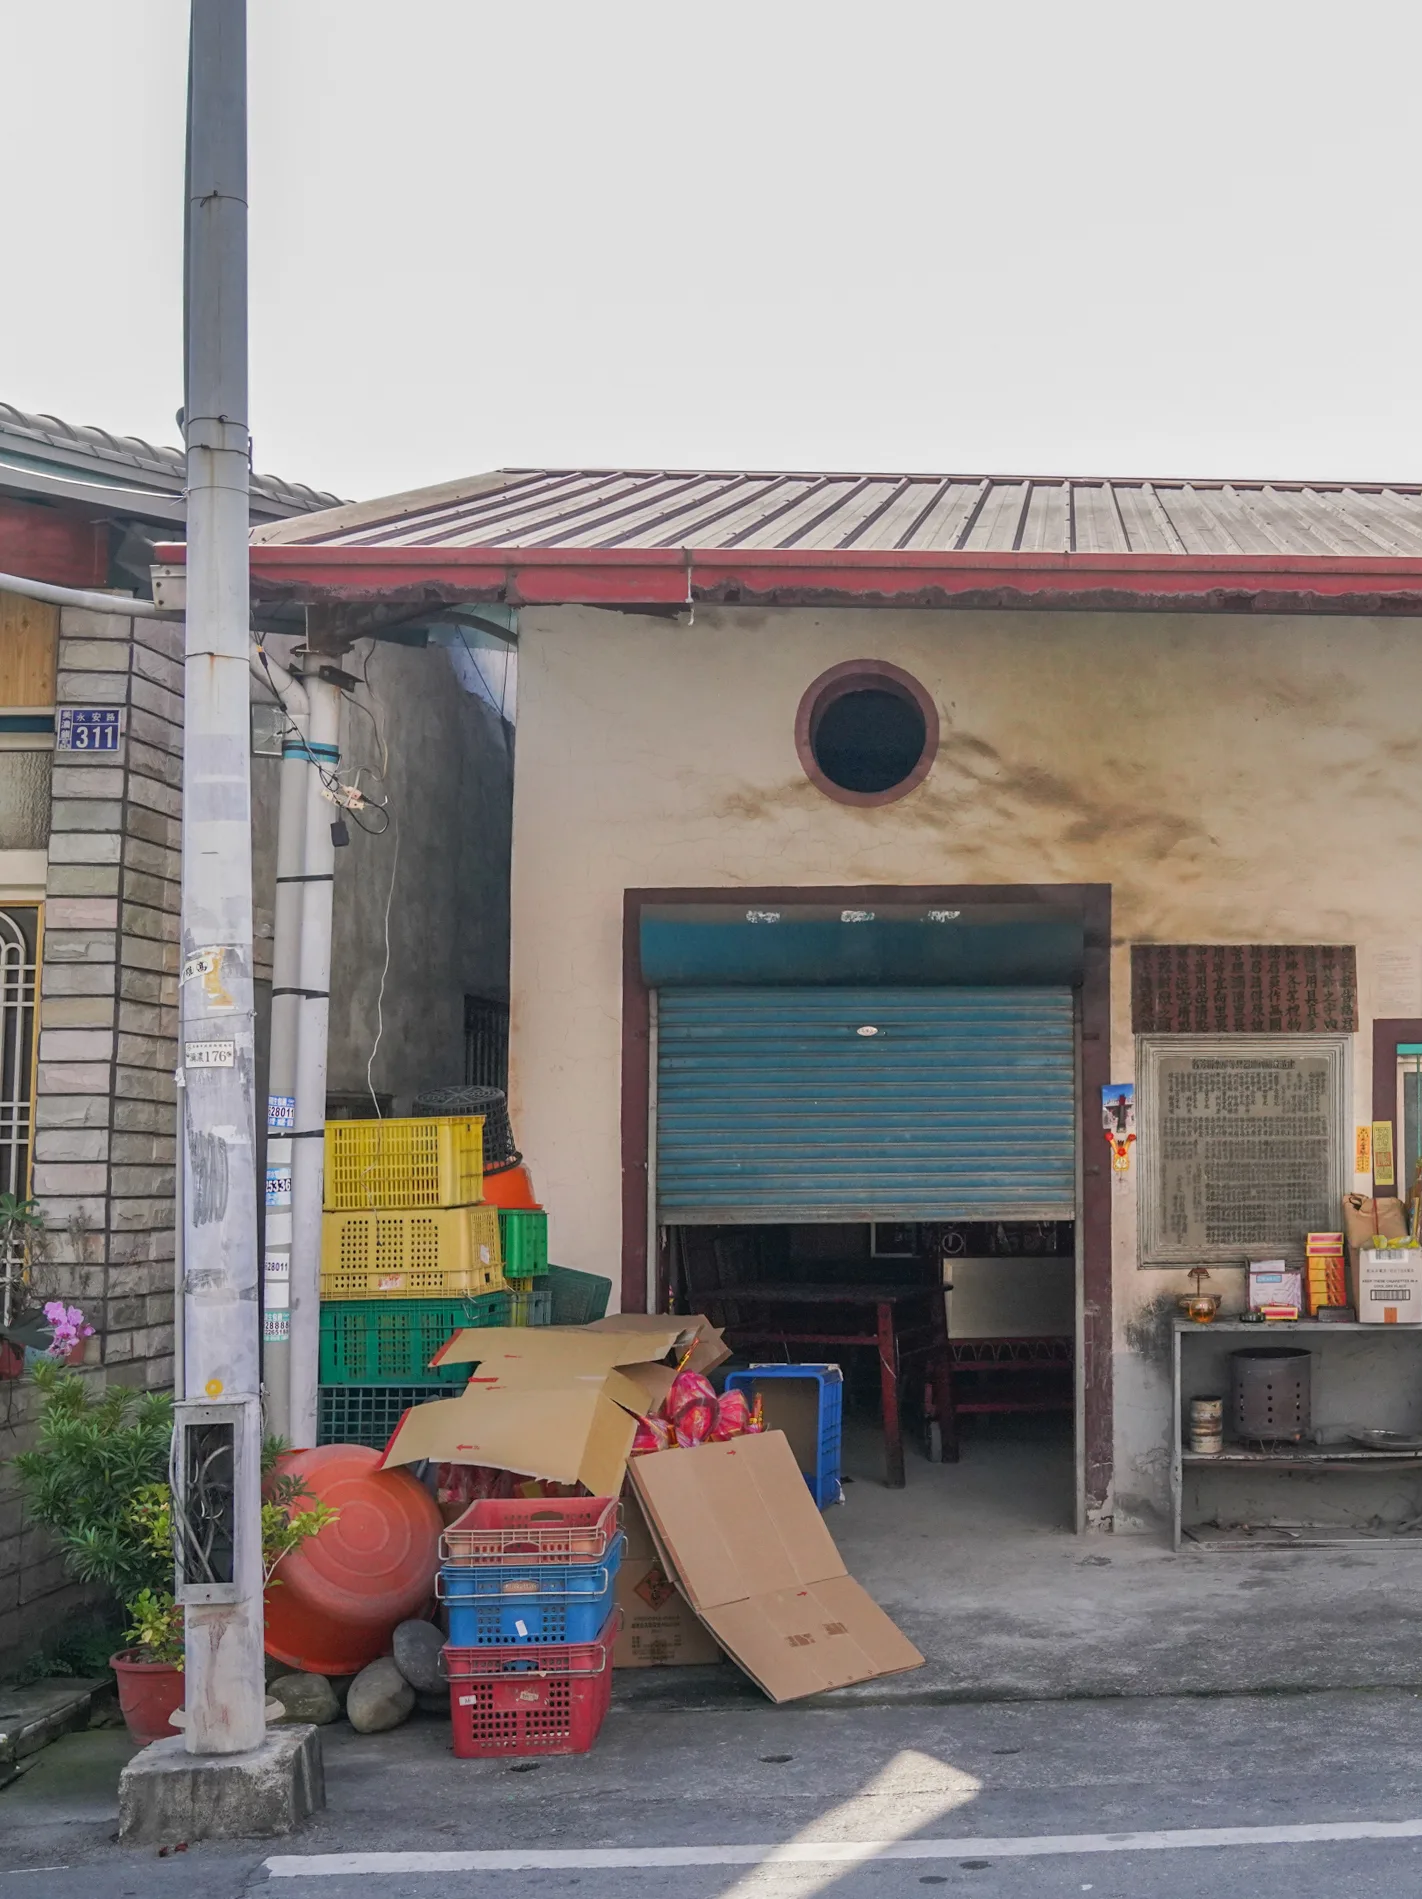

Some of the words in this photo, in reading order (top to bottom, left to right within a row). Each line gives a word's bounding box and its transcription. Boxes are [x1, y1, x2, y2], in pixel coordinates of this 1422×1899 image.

[76, 711, 116, 722] 永安路
[76, 726, 113, 748] 311
